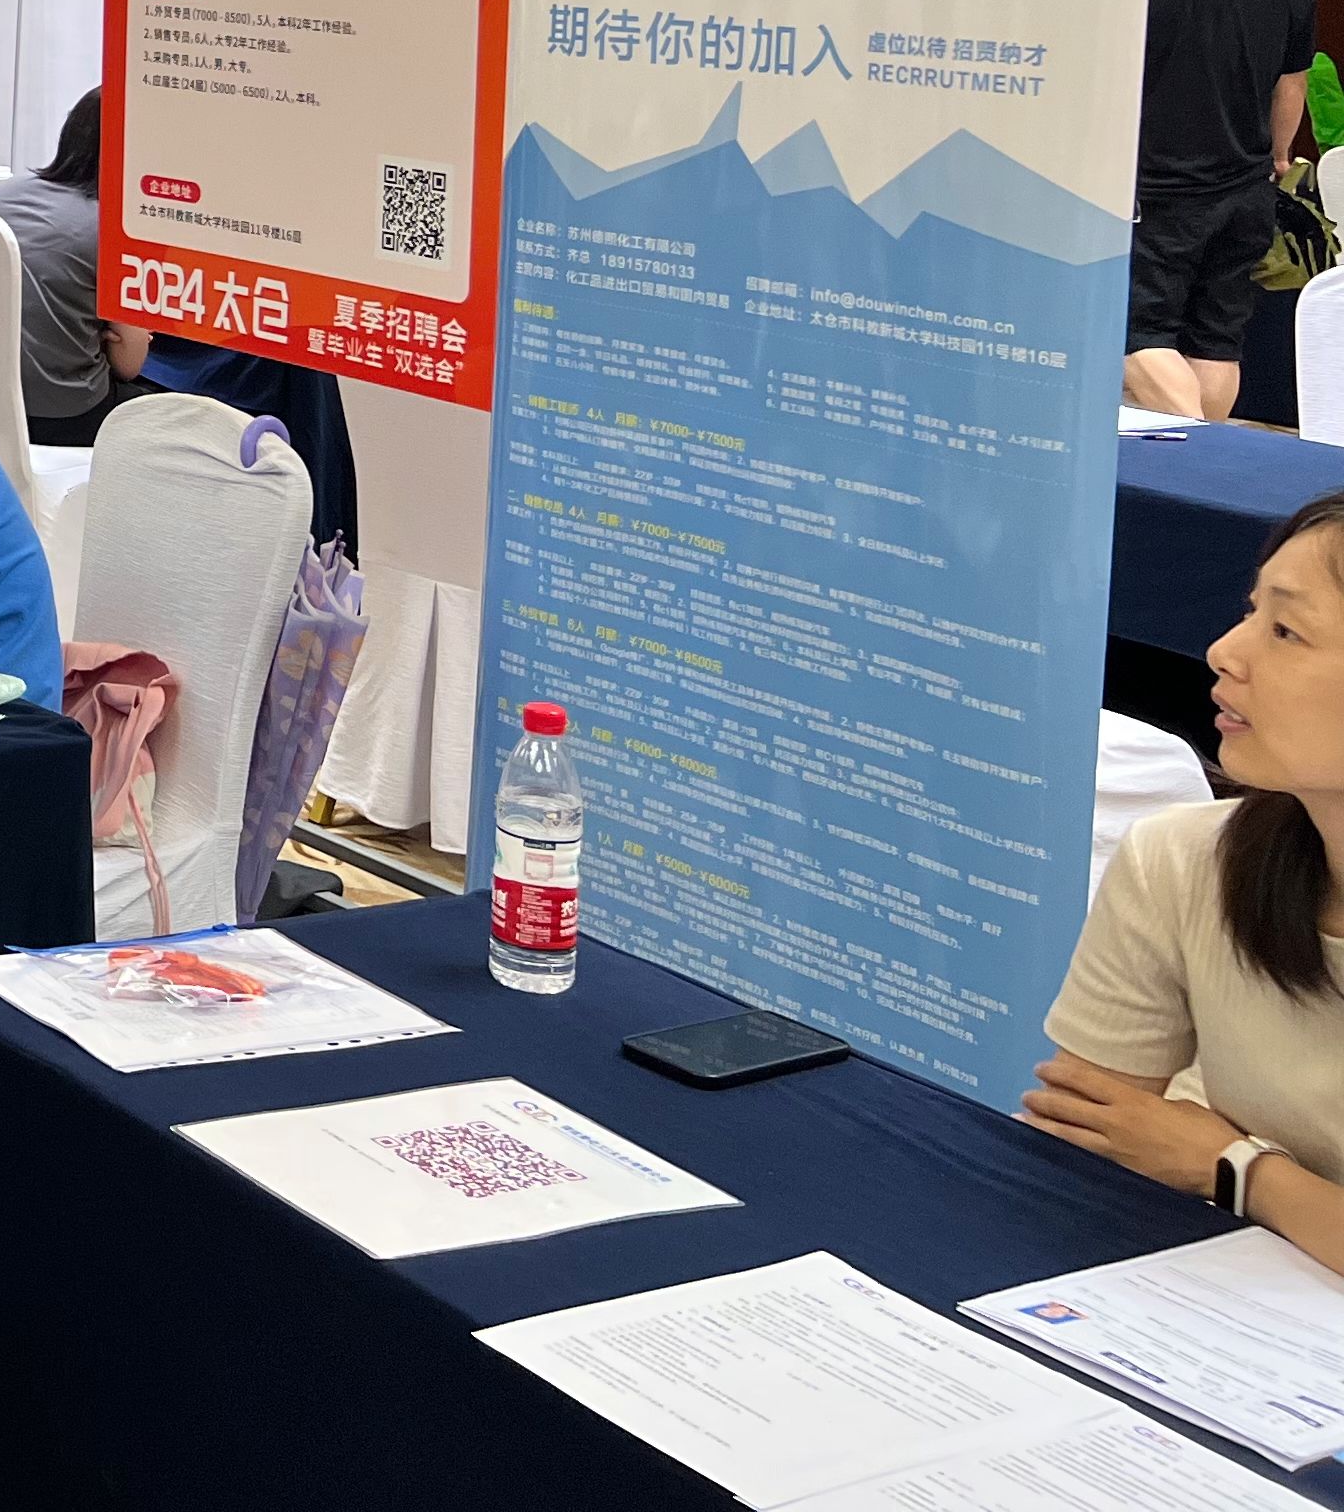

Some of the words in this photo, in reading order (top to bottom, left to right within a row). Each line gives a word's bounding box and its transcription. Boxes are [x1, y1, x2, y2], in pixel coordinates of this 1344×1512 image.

[547, 3, 853, 81] 期待你的加入
[867, 31, 947, 60] 虚位以待
[952, 38, 1047, 67] 招贤纳才
[867, 62, 1045, 96] RECRRUTMENT
[333, 294, 467, 355] 夏季招聘会
[810, 286, 1015, 336] info@douwinchem.com.cn
[306, 327, 465, 386] 暨毕业生“双选会”
